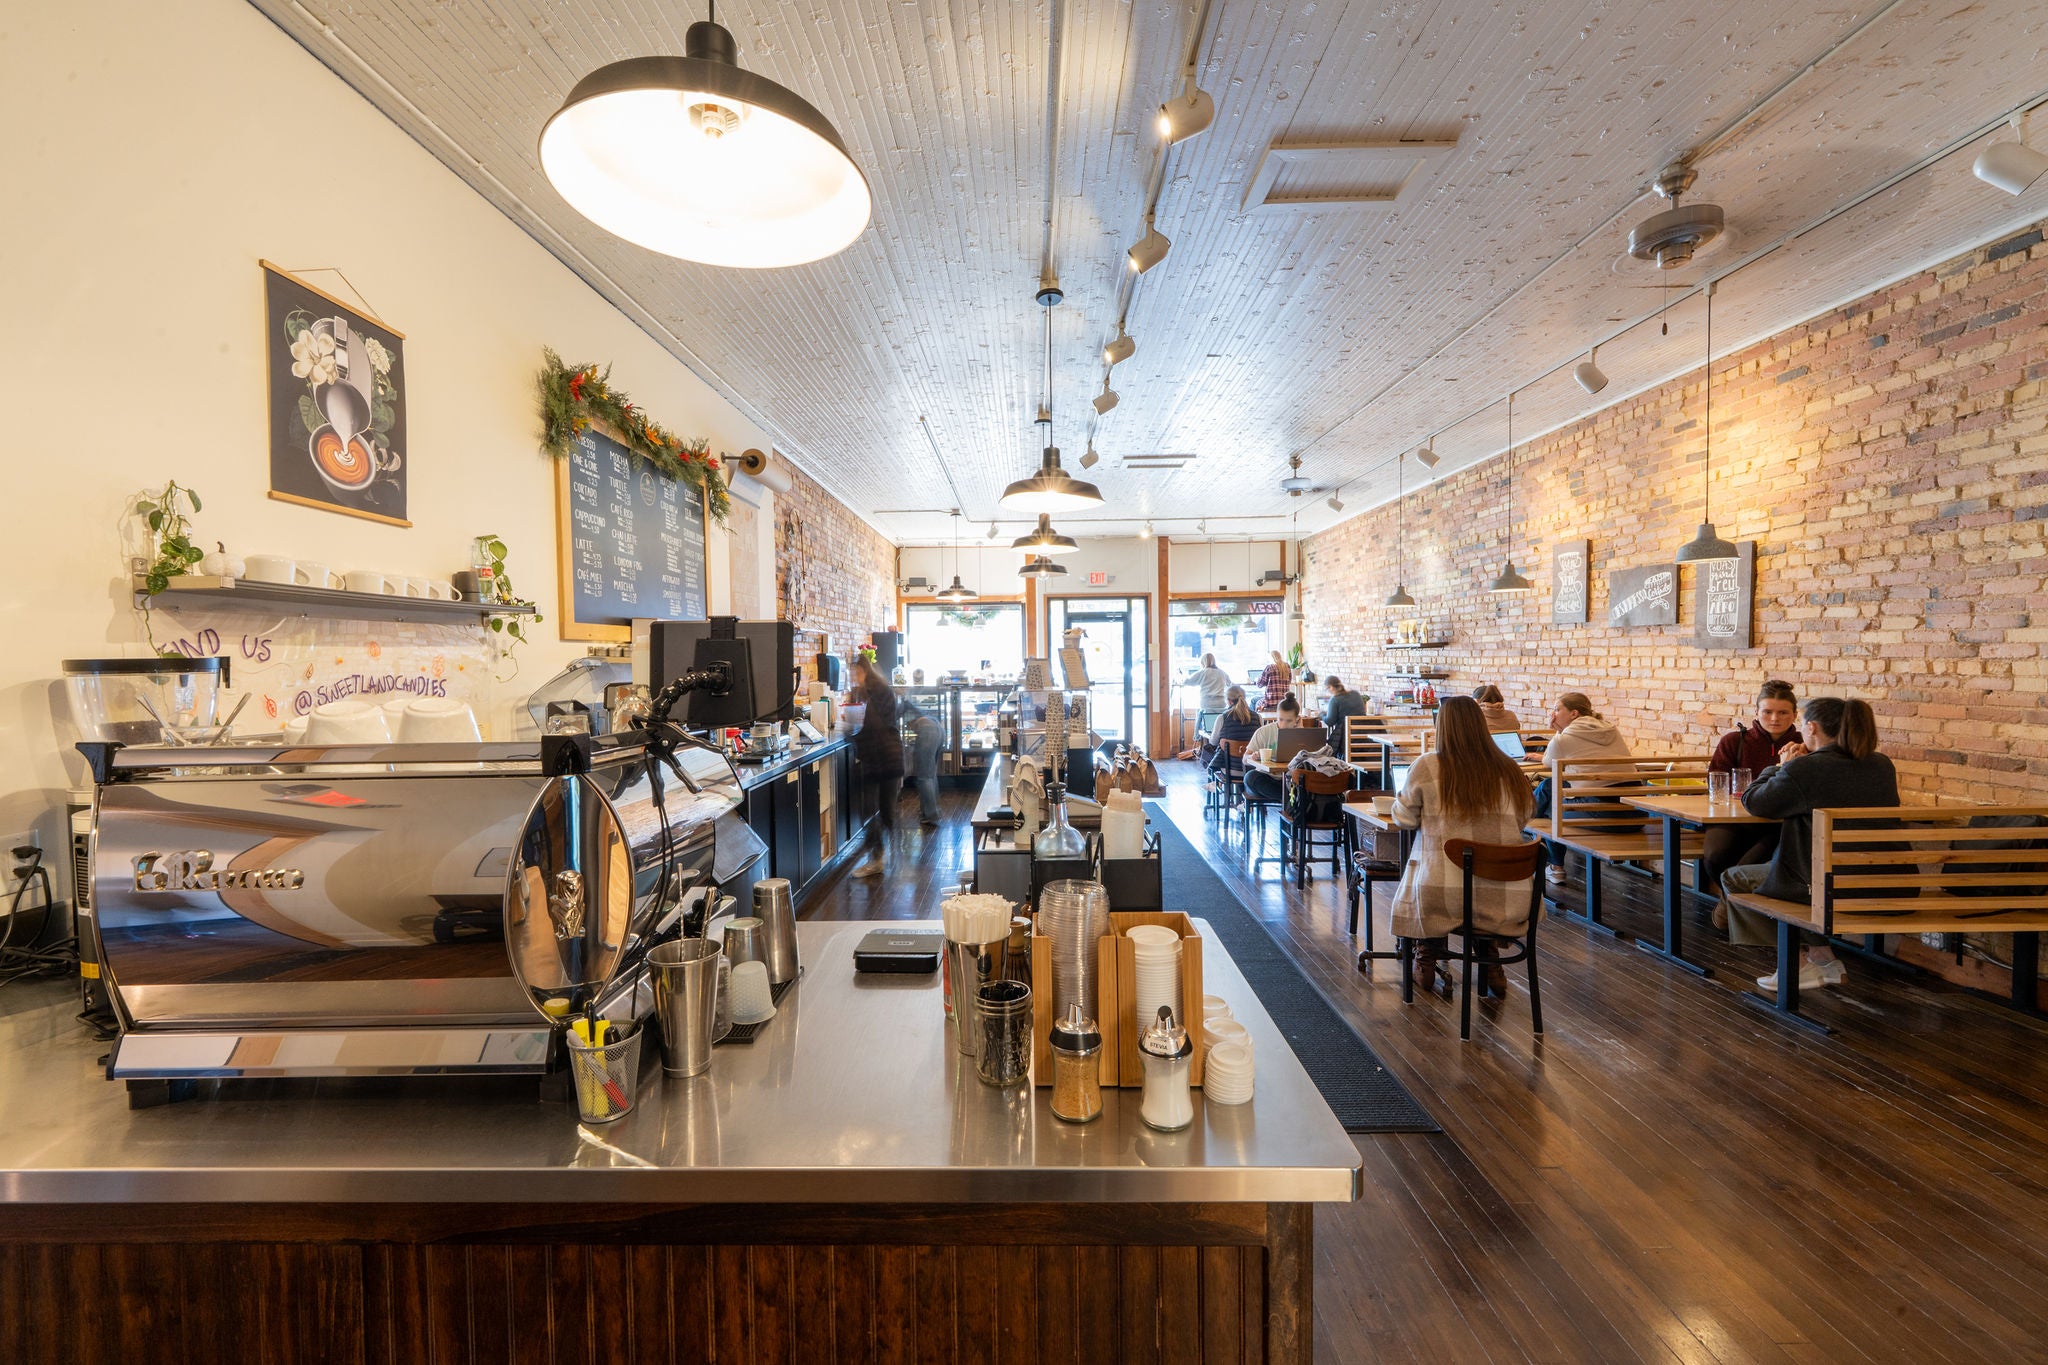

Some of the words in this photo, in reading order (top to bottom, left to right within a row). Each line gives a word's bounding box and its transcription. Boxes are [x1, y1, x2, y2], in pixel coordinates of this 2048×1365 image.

[572, 453, 584, 466] ONE
[588, 460, 599, 473] ONE
[609, 450, 629, 466] MOCHA
[573, 481, 598, 500] CORTADO
[608, 475, 628, 492] TURTLE
[574, 508, 606, 528] CAPPUCCINO
[575, 537, 593, 552] LATTE
[613, 579, 635, 593] MATCHA
[1089, 572, 1105, 584] EXIT
[1709, 602, 1735, 614] AERO
[242, 633, 272, 662] US
[1150, 1042, 1168, 1050] STEVIA
